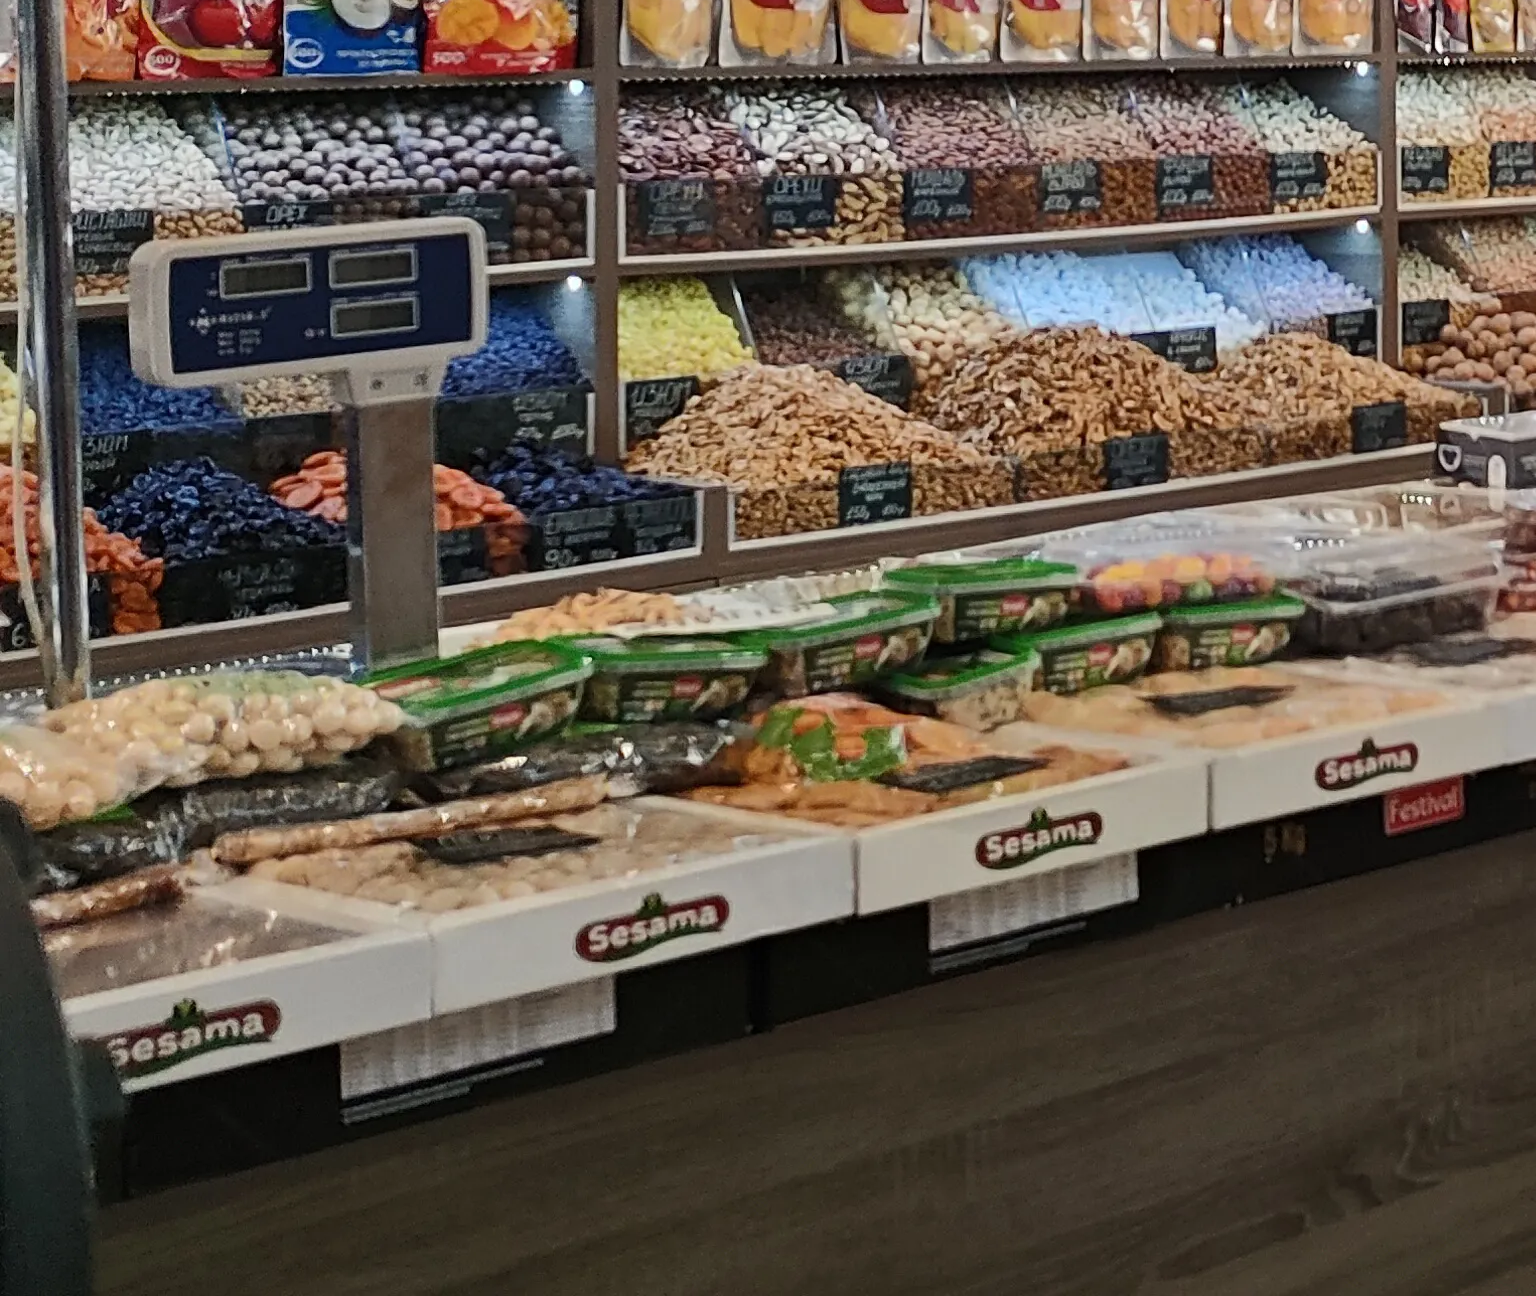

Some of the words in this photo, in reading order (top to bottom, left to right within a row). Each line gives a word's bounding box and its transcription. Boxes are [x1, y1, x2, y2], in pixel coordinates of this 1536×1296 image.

[75, 212, 148, 231] ИСТАШКИ
[266, 204, 309, 224] ОРЕХ
[82, 435, 129, 455] ЗЮМ
[1324, 749, 1413, 784] Sesama
[1389, 784, 1459, 825] Festival
[985, 819, 1094, 862] Sesama
[587, 904, 719, 953] Sesama
[106, 1012, 265, 1067] Sesama
